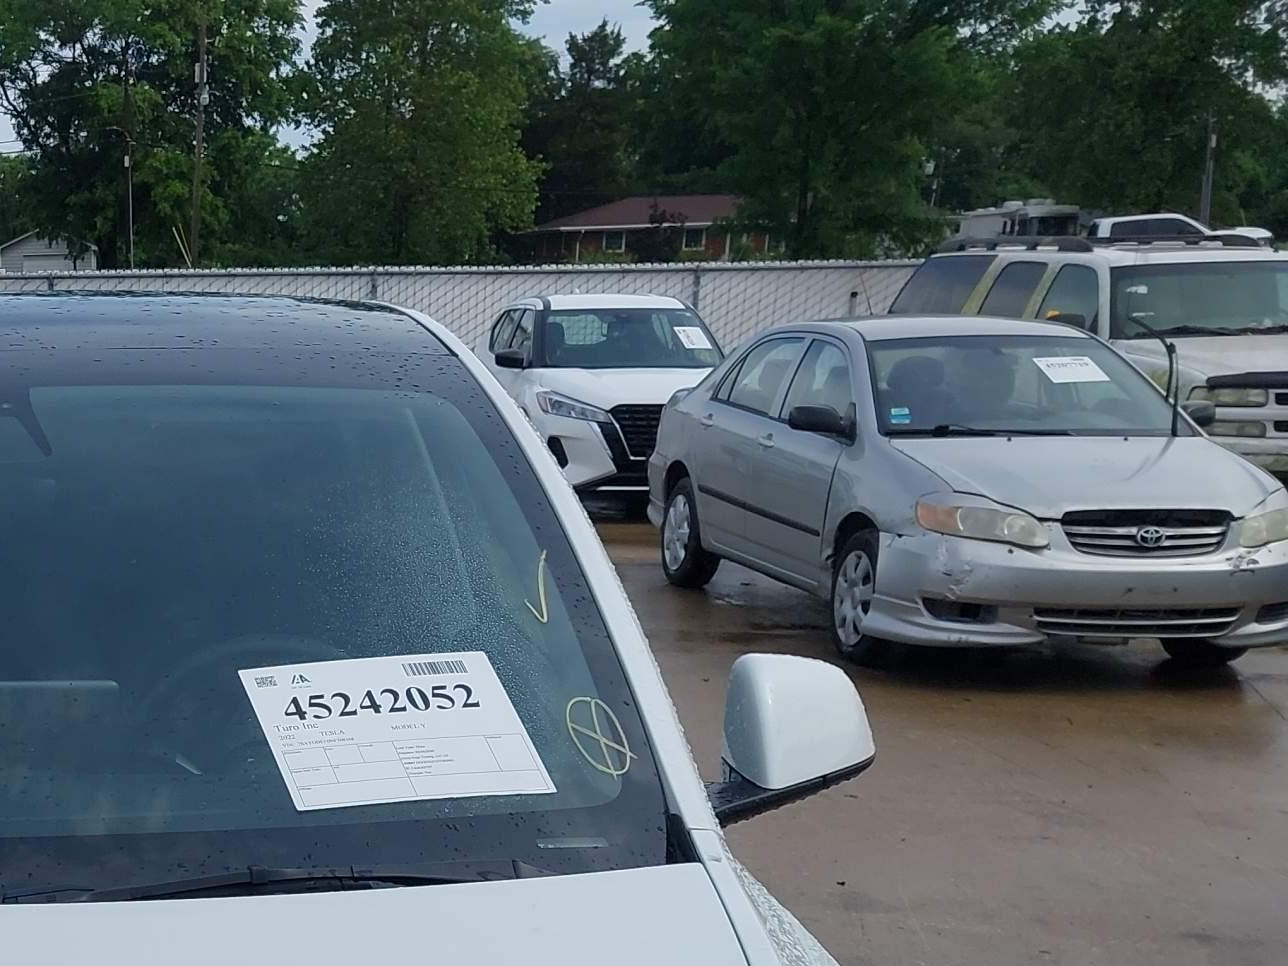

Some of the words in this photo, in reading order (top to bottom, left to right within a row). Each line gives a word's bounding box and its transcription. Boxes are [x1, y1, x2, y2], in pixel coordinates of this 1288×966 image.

[284, 683, 481, 721] 45242052
[273, 724, 300, 733] Turo
[302, 722, 319, 730] Inc
